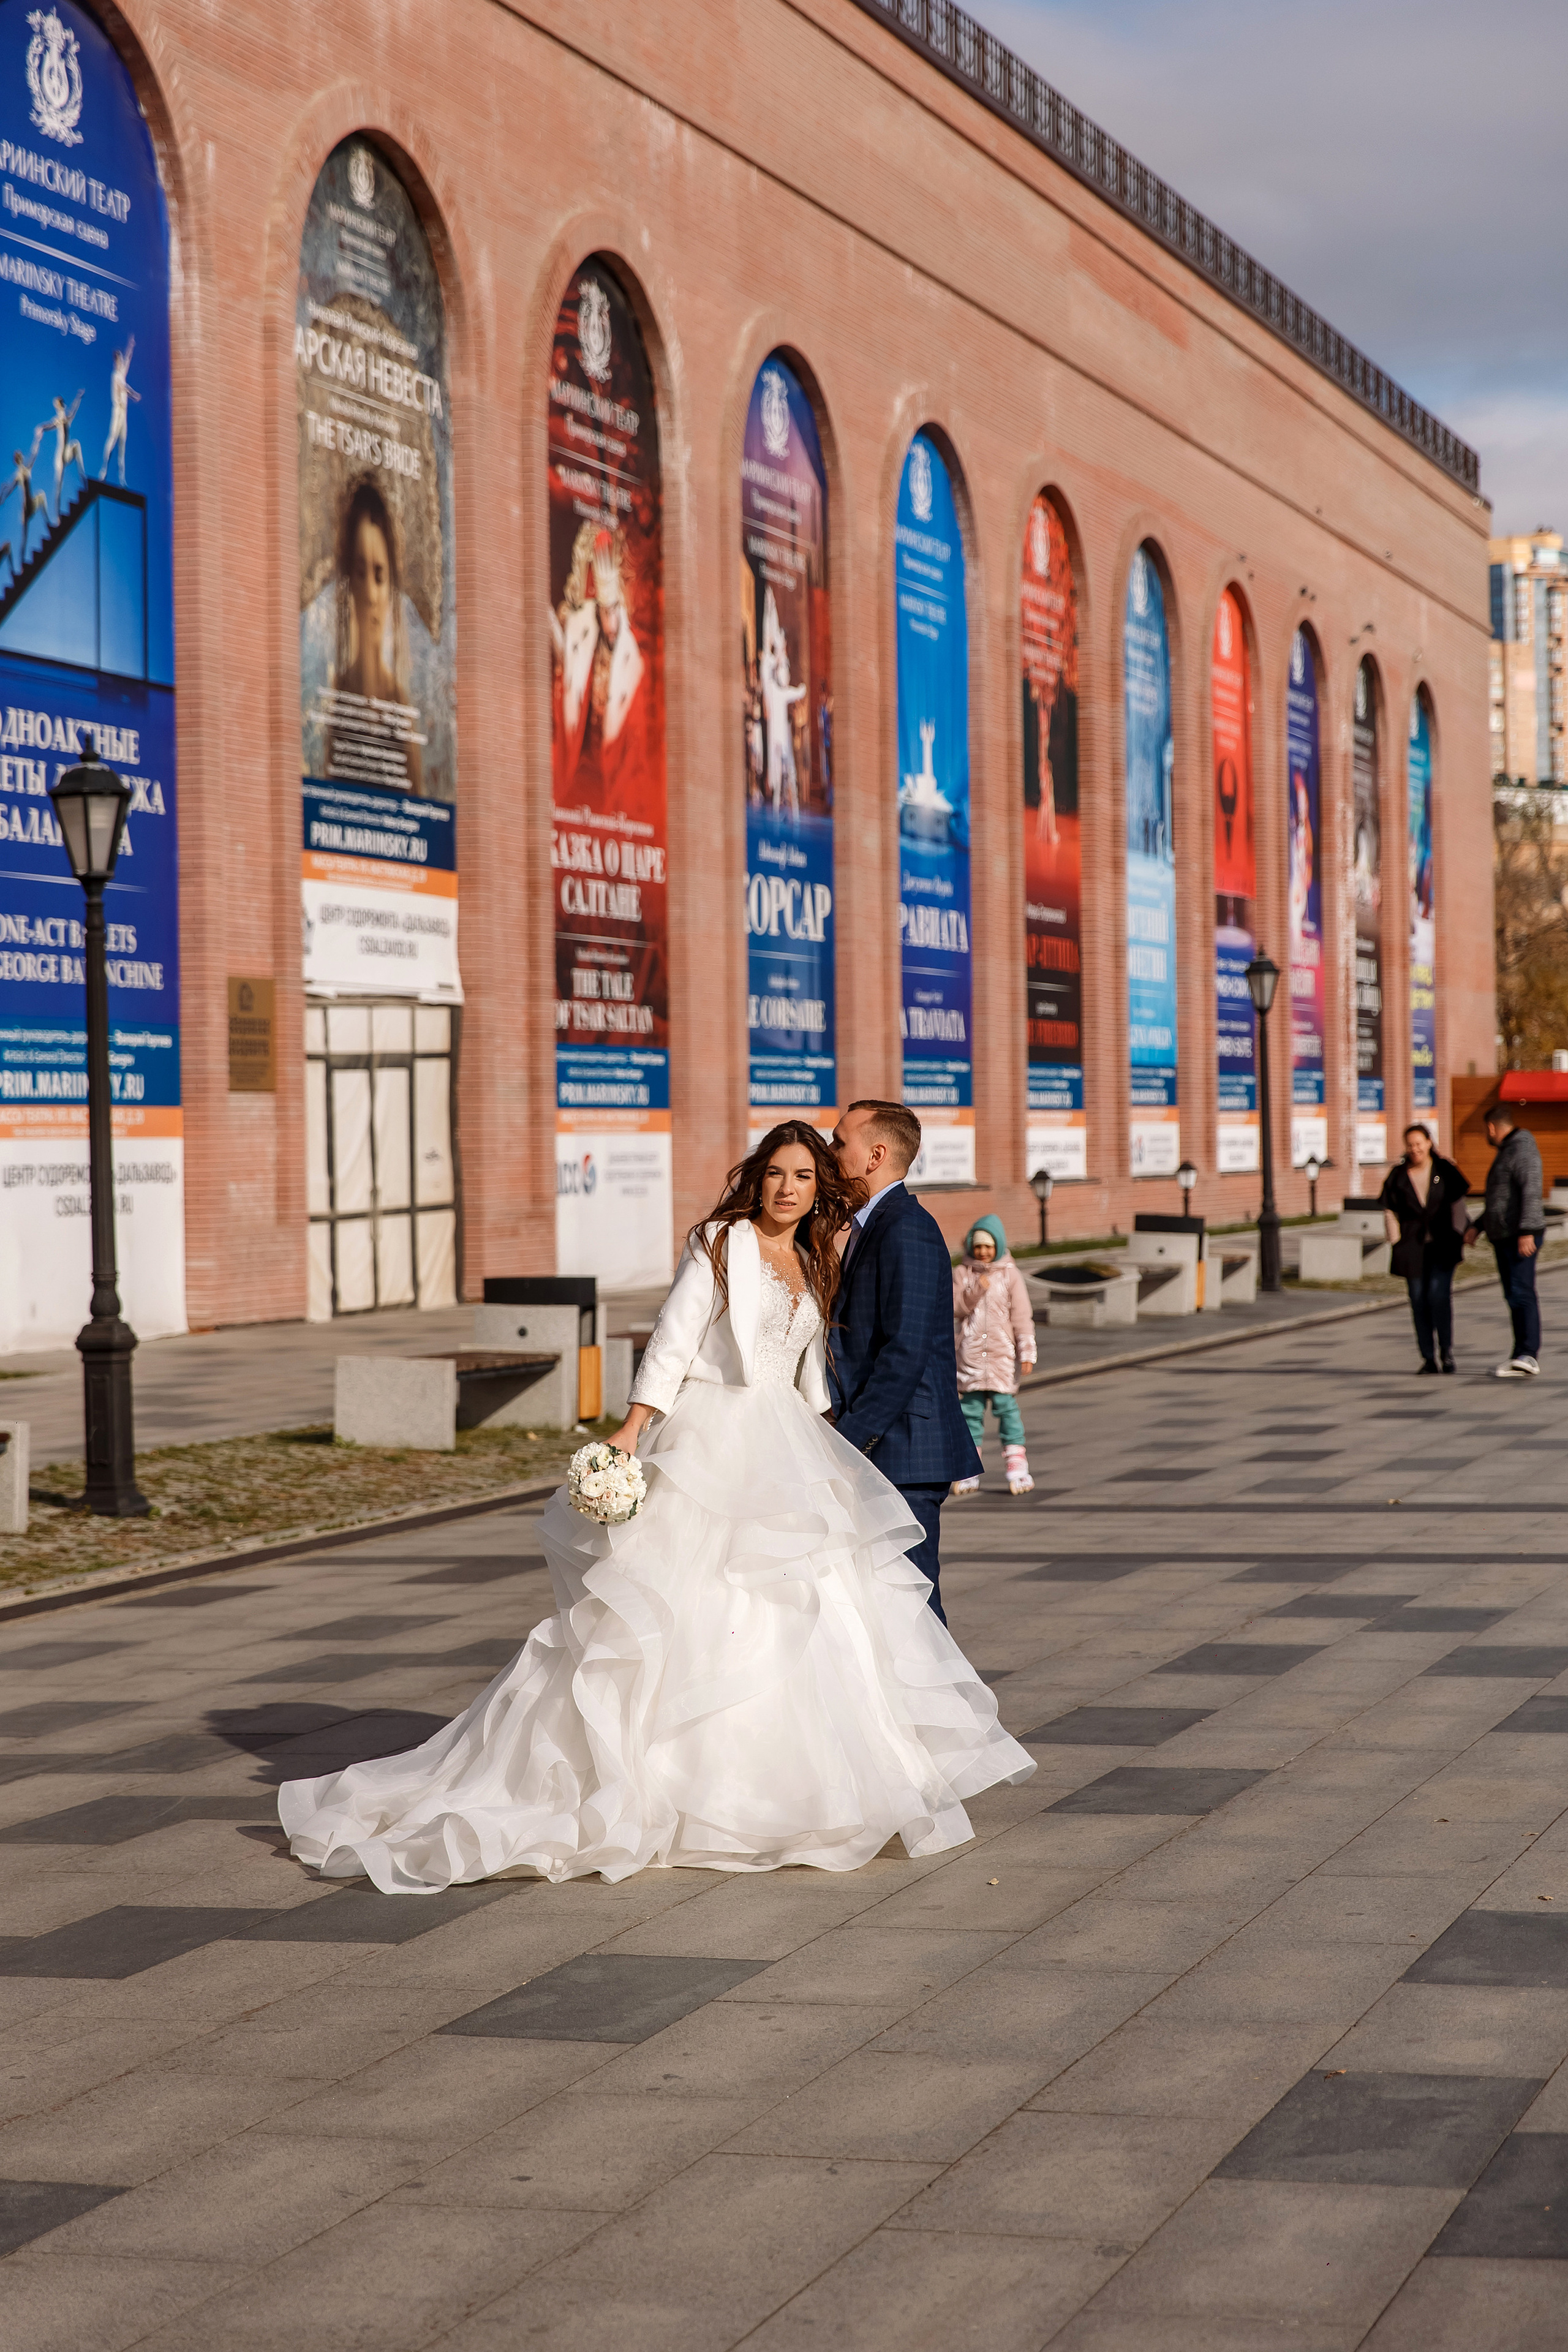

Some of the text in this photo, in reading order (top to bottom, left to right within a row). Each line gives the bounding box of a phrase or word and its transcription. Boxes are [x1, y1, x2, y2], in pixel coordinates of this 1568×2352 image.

[2, 181, 109, 250] Приморская сцена
[87, 177, 131, 224] ТЕАТР
[19, 293, 97, 345] Primorsky Stage
[66, 276, 119, 322] THEATRE
[368, 351, 444, 420] НЕВЕСТА
[306, 409, 337, 451] THE
[381, 436, 422, 481] BRIDE
[560, 875, 643, 922] САЛТАНЕ
